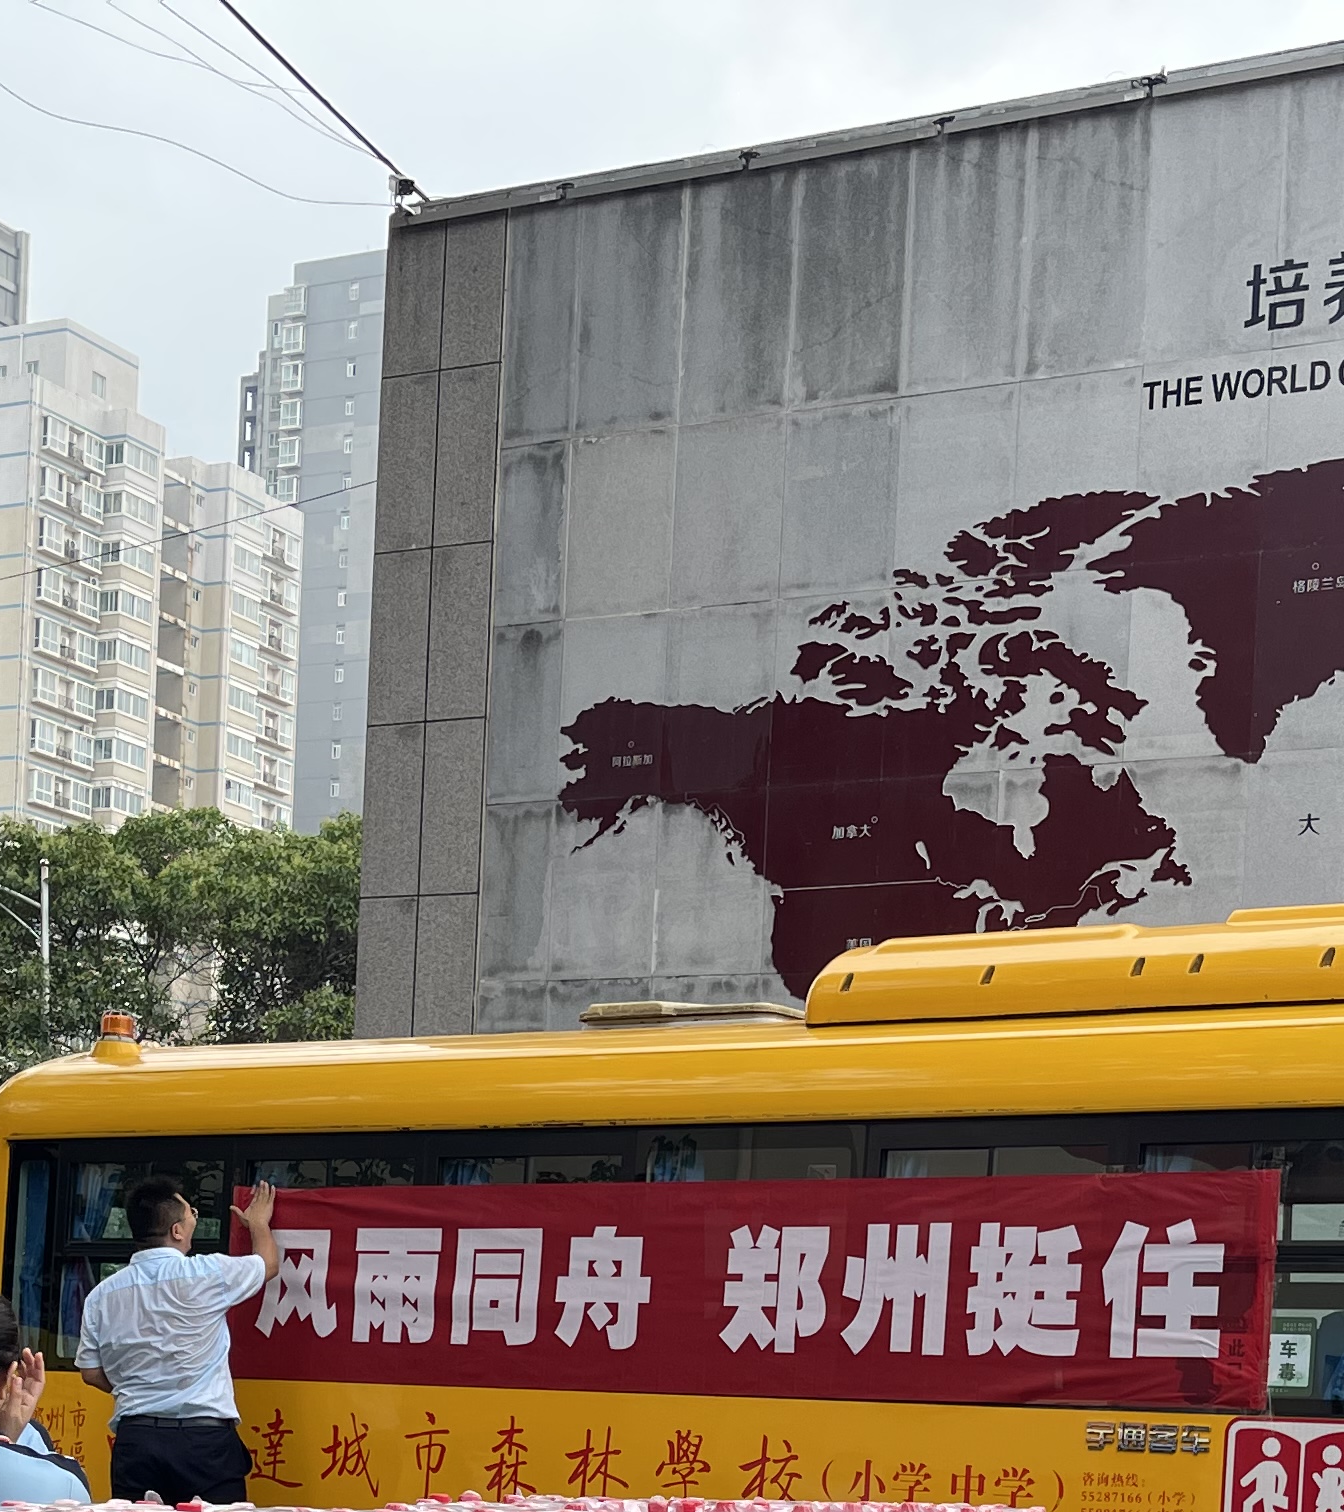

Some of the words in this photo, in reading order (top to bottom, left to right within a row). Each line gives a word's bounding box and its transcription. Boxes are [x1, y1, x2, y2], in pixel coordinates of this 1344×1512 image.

[1143, 375, 1203, 411] THE
[1211, 360, 1332, 401] WORLD
[611, 753, 654, 768] 阿拉斯加
[831, 823, 872, 840] 加拿大
[1297, 813, 1321, 836] 大
[255, 1225, 651, 1350] 风雨同舟
[718, 1218, 1226, 1359] 郑州挺住
[1279, 1339, 1298, 1359] 车
[1277, 1362, 1297, 1382] 毒
[1085, 1421, 1212, 1456] 宇通客车
[1082, 1471, 1146, 1488] 咨询热线：
